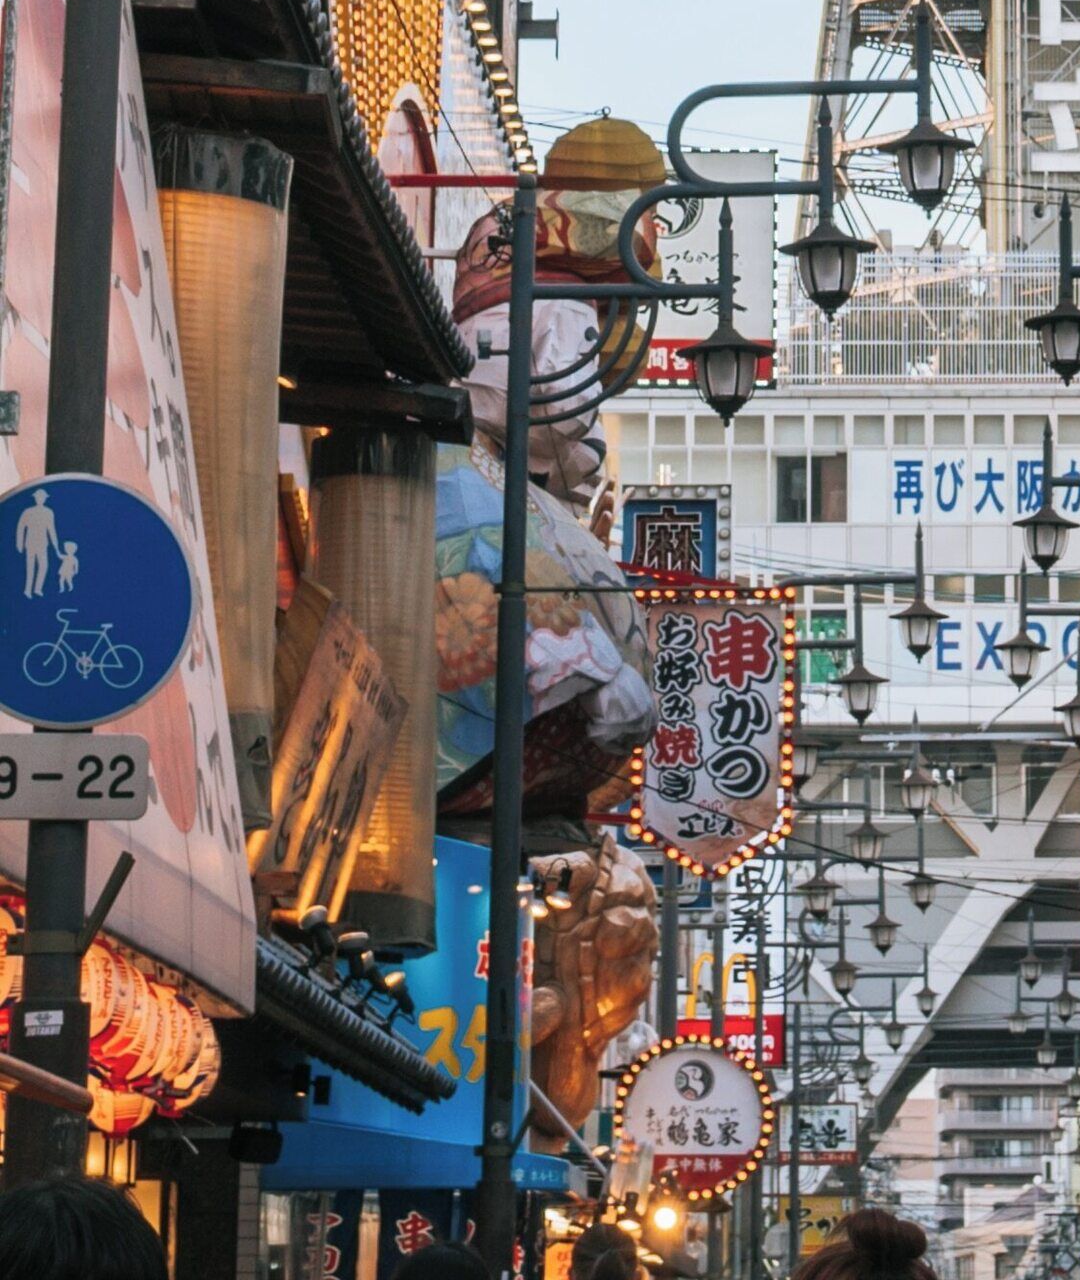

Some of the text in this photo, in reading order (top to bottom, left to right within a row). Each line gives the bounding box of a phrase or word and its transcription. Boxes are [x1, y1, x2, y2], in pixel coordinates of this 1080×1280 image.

[653, 615, 700, 800] お好み焼き
[705, 614, 771, 796] 串かつ
